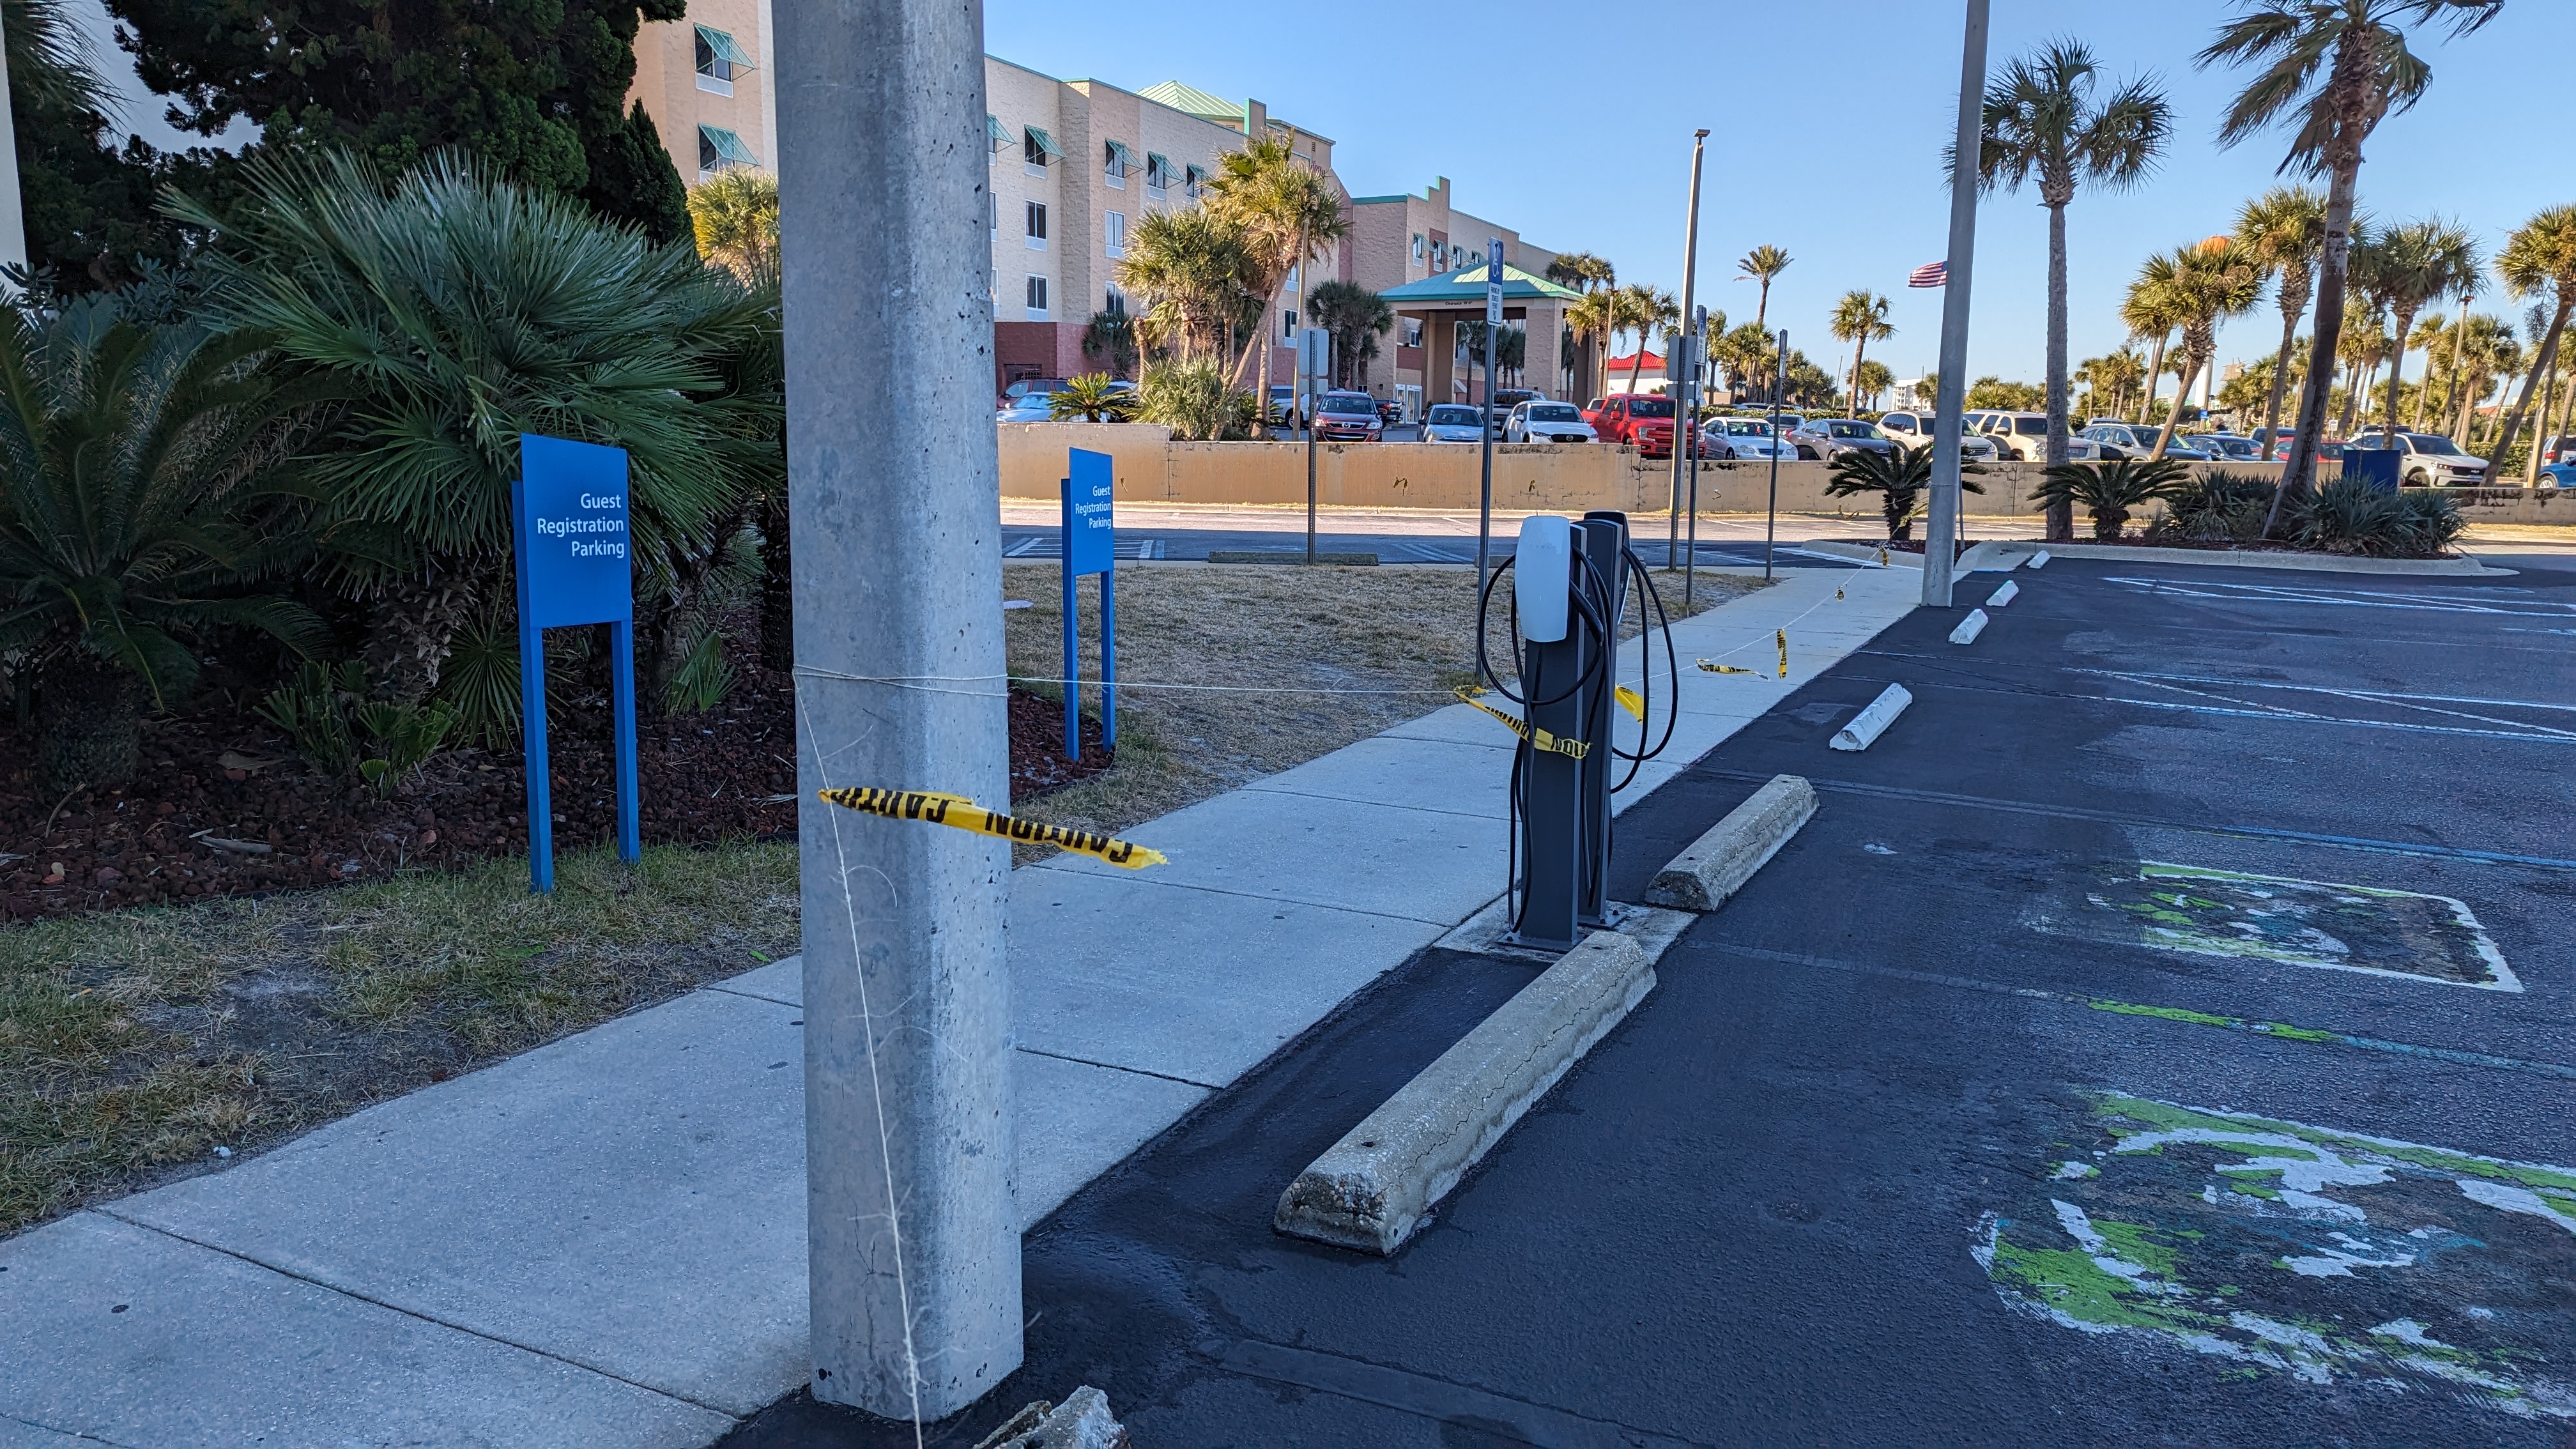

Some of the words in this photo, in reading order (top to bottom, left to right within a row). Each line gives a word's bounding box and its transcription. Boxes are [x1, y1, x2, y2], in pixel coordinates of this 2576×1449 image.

[1092, 486, 1111, 496] Guest
[580, 493, 622, 509] Guest
[1075, 501, 1112, 516] Registration
[537, 516, 624, 538] Registration
[1089, 516, 1112, 530] Parking
[571, 539, 625, 559] Parking
[985, 811, 1134, 863] CAUTION
